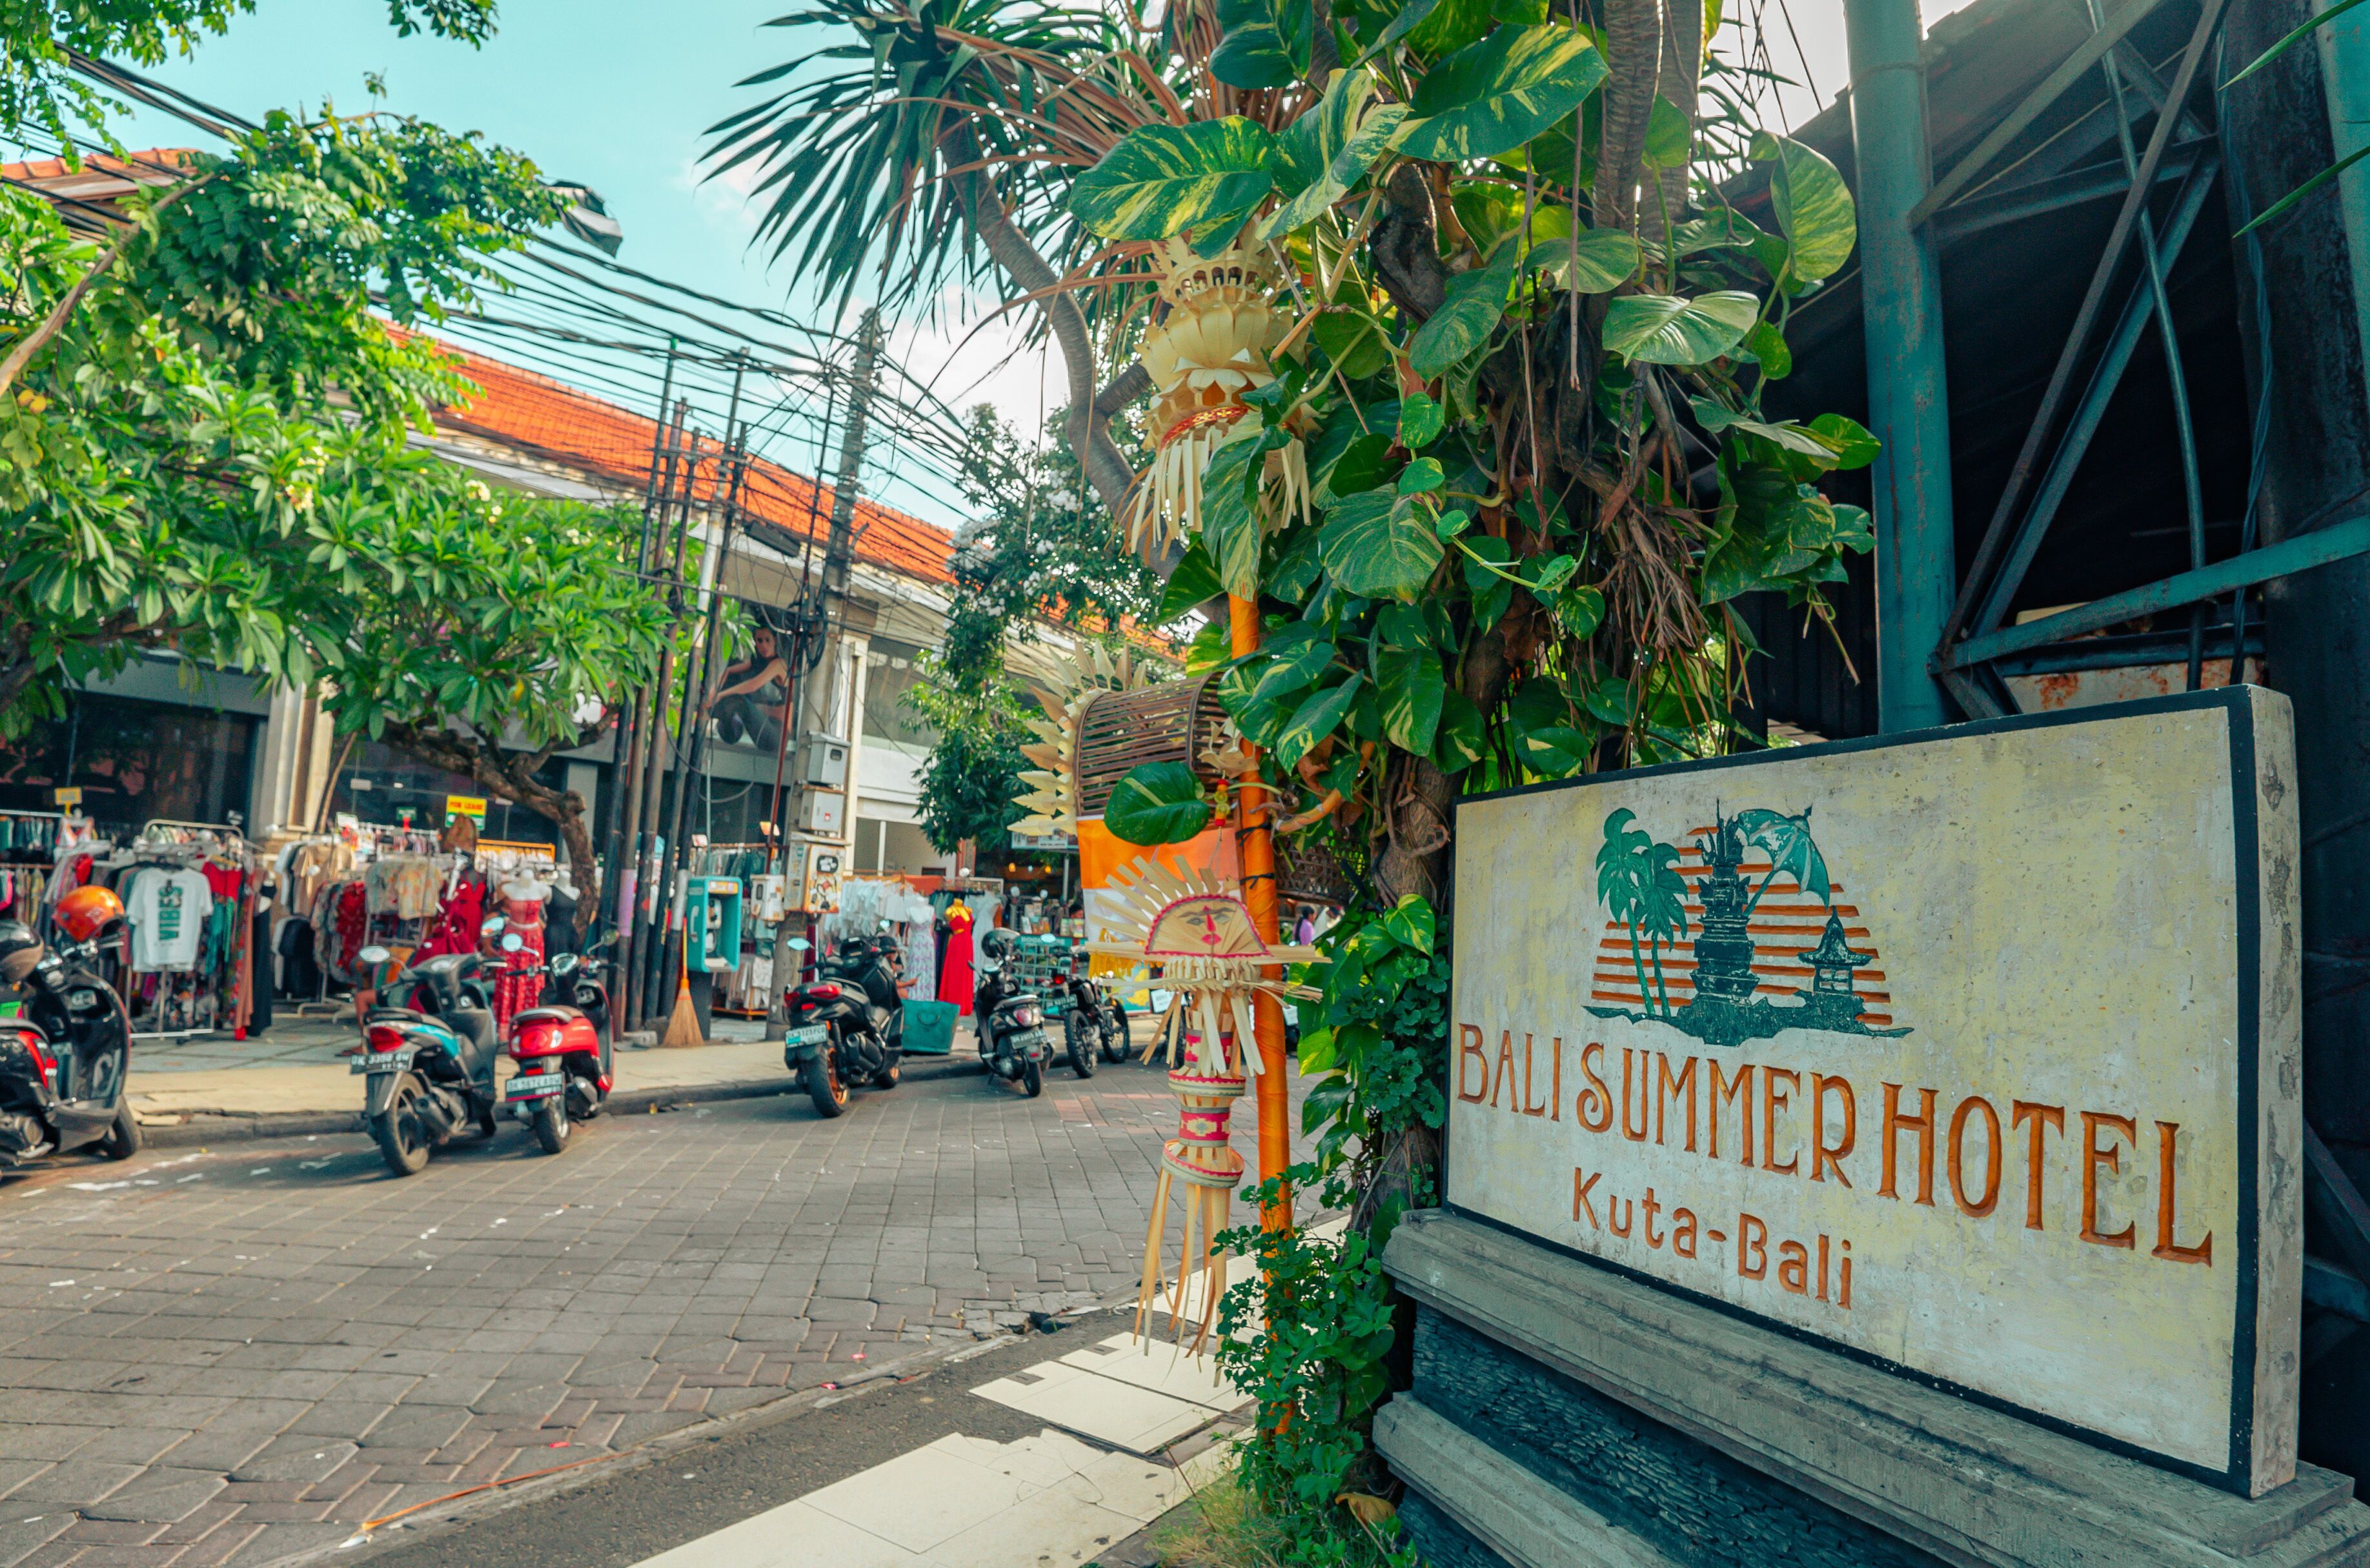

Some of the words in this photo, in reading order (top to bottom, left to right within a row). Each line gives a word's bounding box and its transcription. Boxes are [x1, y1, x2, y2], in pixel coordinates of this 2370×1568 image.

[1457, 1022, 1562, 1122] BALI
[1576, 1042, 1856, 1189] SUMMER
[1876, 1081, 2213, 1269] HOTEL
[1572, 1167, 1852, 1311] Kuta-Bali
